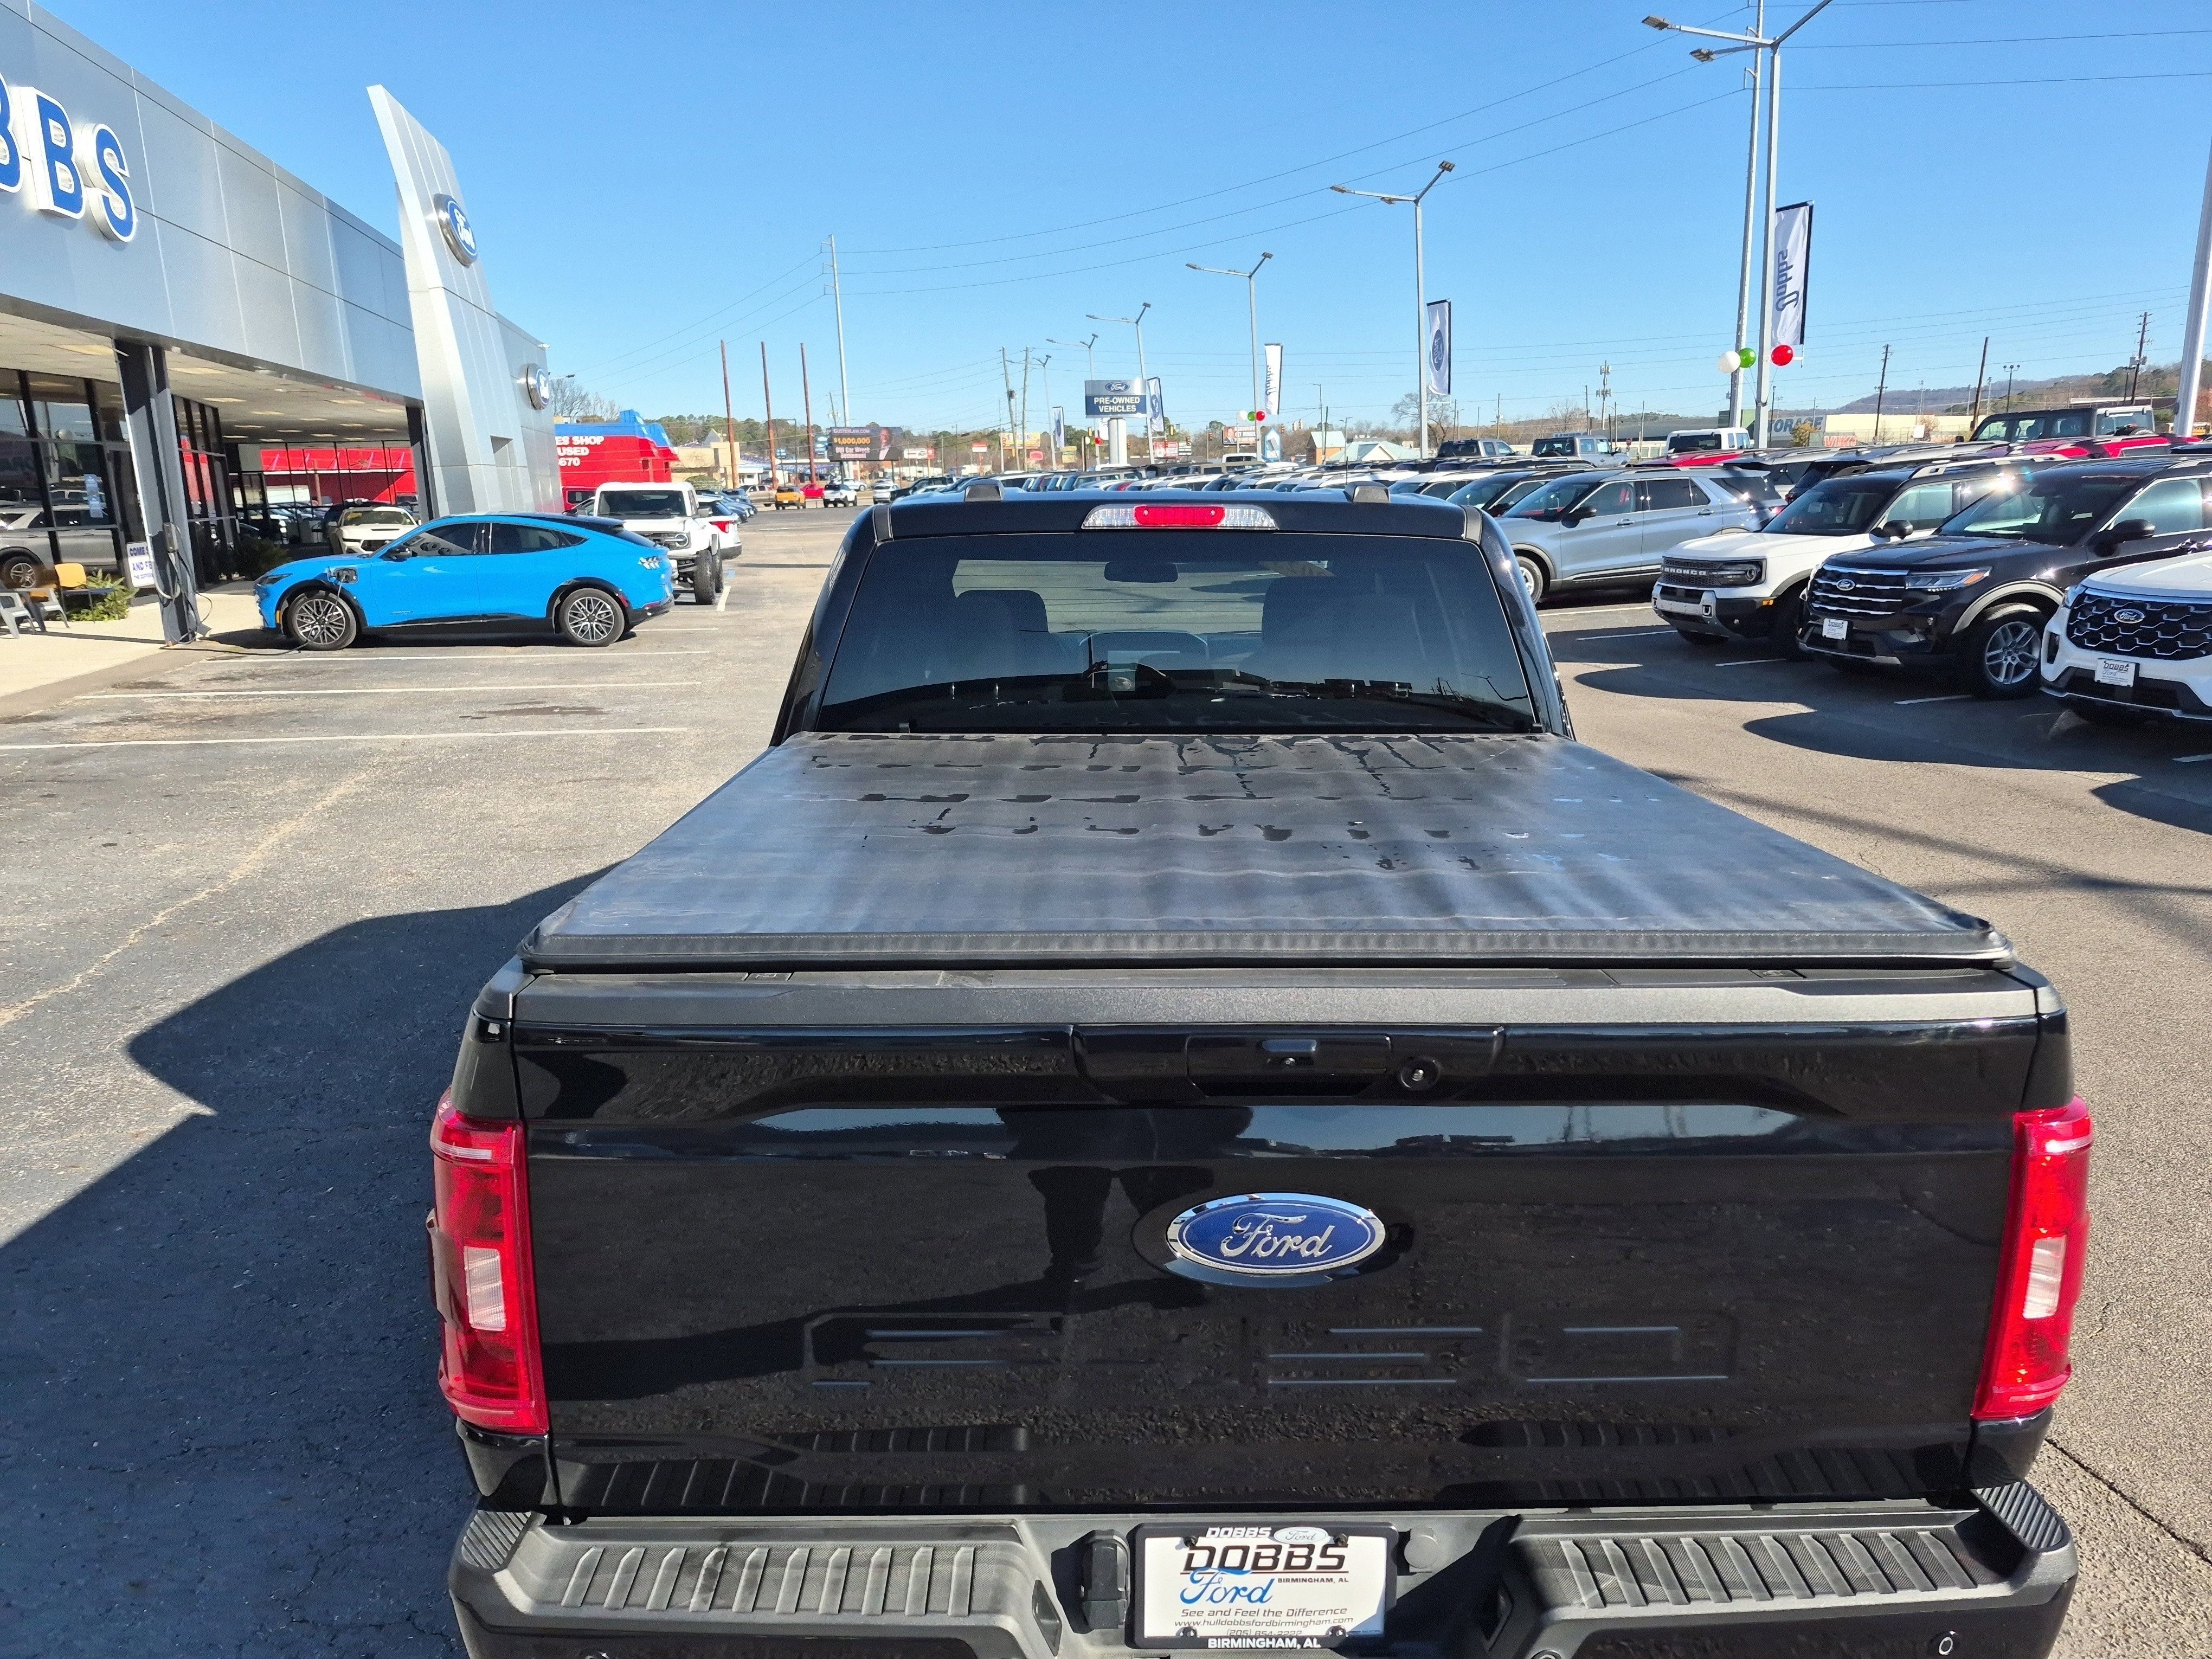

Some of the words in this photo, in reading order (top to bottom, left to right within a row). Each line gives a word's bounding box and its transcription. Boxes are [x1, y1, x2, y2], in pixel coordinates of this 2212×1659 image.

[454, 208, 476, 250] Ford
[572, 436, 605, 445] SHOP
[833, 437, 871, 445] $1,000,000
[557, 446, 589, 456] USED
[1664, 567, 1707, 575] BRONCO
[2119, 611, 2137, 620] Ford
[2103, 663, 2129, 672] DOBBS
[1220, 1212, 1335, 1258] Ford
[1205, 1526, 1272, 1538] DOBBS
[1284, 1530, 1316, 1541] Ford
[1183, 1544, 1349, 1571] DOBBS
[1180, 1566, 1276, 1604] Ford
[1181, 1609, 1204, 1617] See
[1207, 1607, 1232, 1617] and
[1234, 1607, 1259, 1617] Feel
[1263, 1608, 1283, 1617] the
[1286, 1607, 1348, 1617] Difference
[1174, 1617, 1354, 1628] www.hulldobbsfordbirmingham.com
[1207, 1637, 1301, 1649] BIRMINGHAM,
[1303, 1637, 1322, 1648] AL
